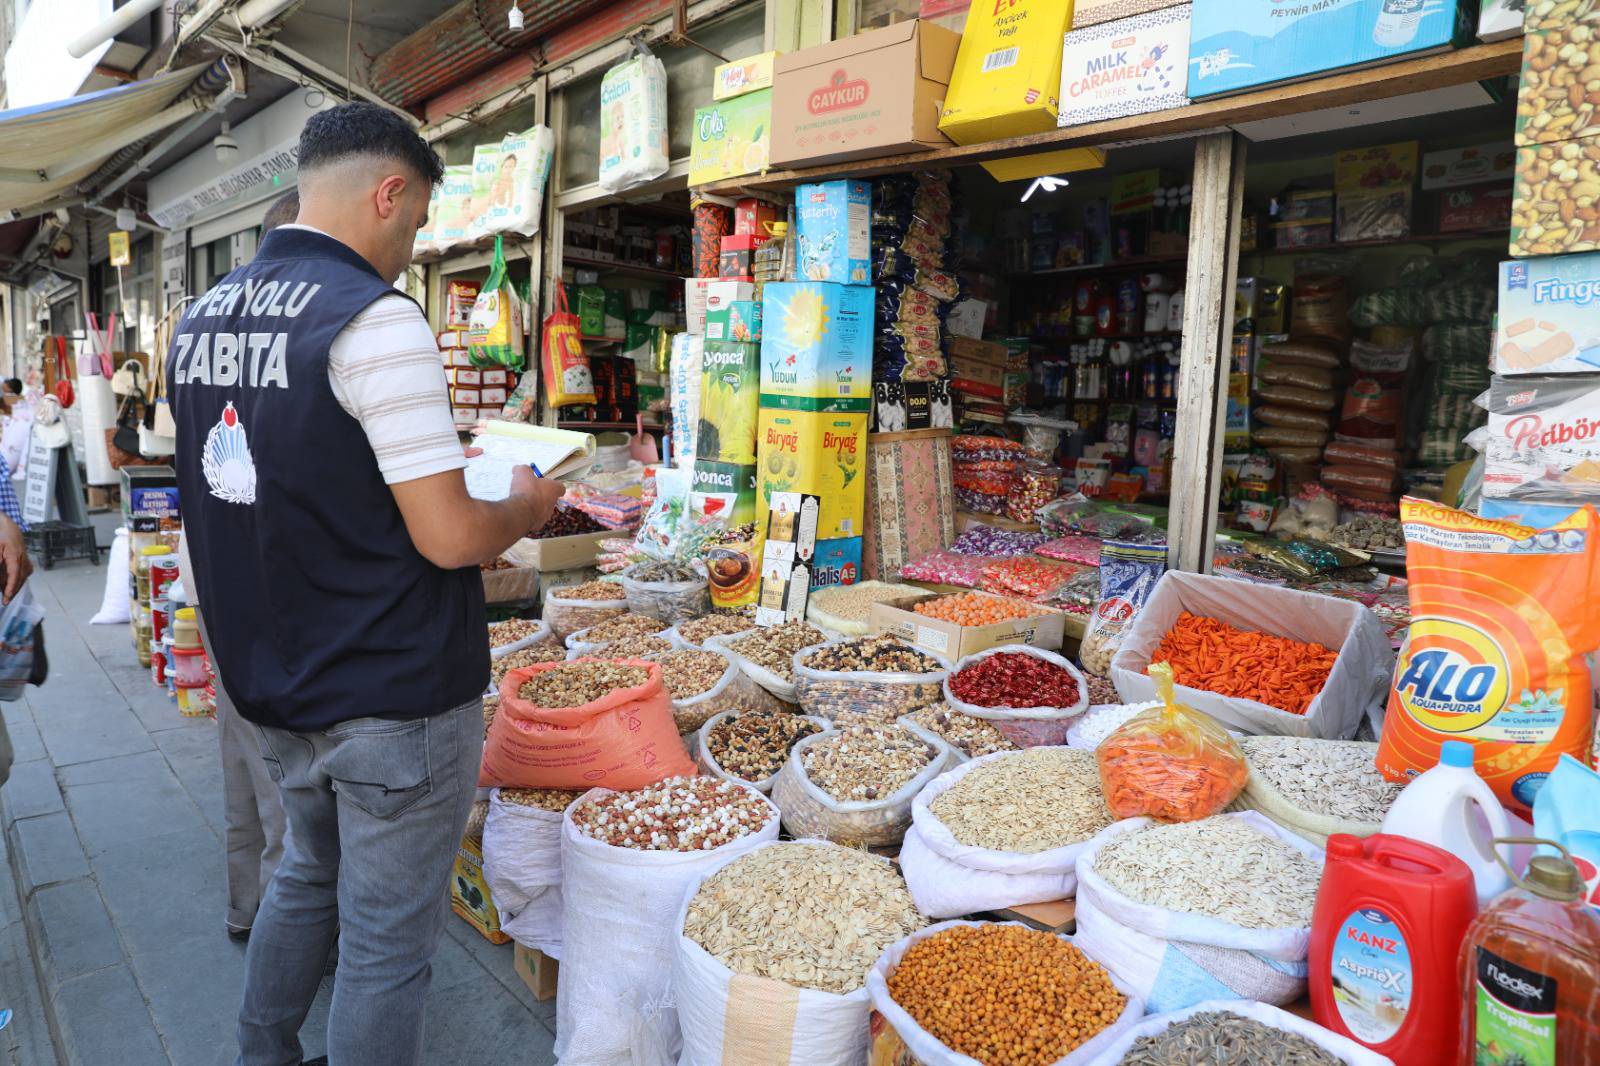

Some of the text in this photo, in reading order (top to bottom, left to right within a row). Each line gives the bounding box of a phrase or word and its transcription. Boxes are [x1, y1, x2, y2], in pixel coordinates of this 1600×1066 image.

[1087, 51, 1128, 75] MILK
[1070, 66, 1144, 98] CARAMEL
[174, 332, 289, 388] ZABITA
[704, 350, 744, 366] yonca
[770, 359, 797, 384] YUDUM
[910, 398, 926, 406] DOJO
[767, 428, 798, 452] Biryağ
[822, 432, 858, 454] Biryağ
[692, 469, 733, 487] yonca
[812, 566, 840, 587] Halis
[1396, 650, 1496, 702] ALO
[1348, 926, 1396, 954] KANZ
[1486, 1000, 1550, 1038] Tropikal
